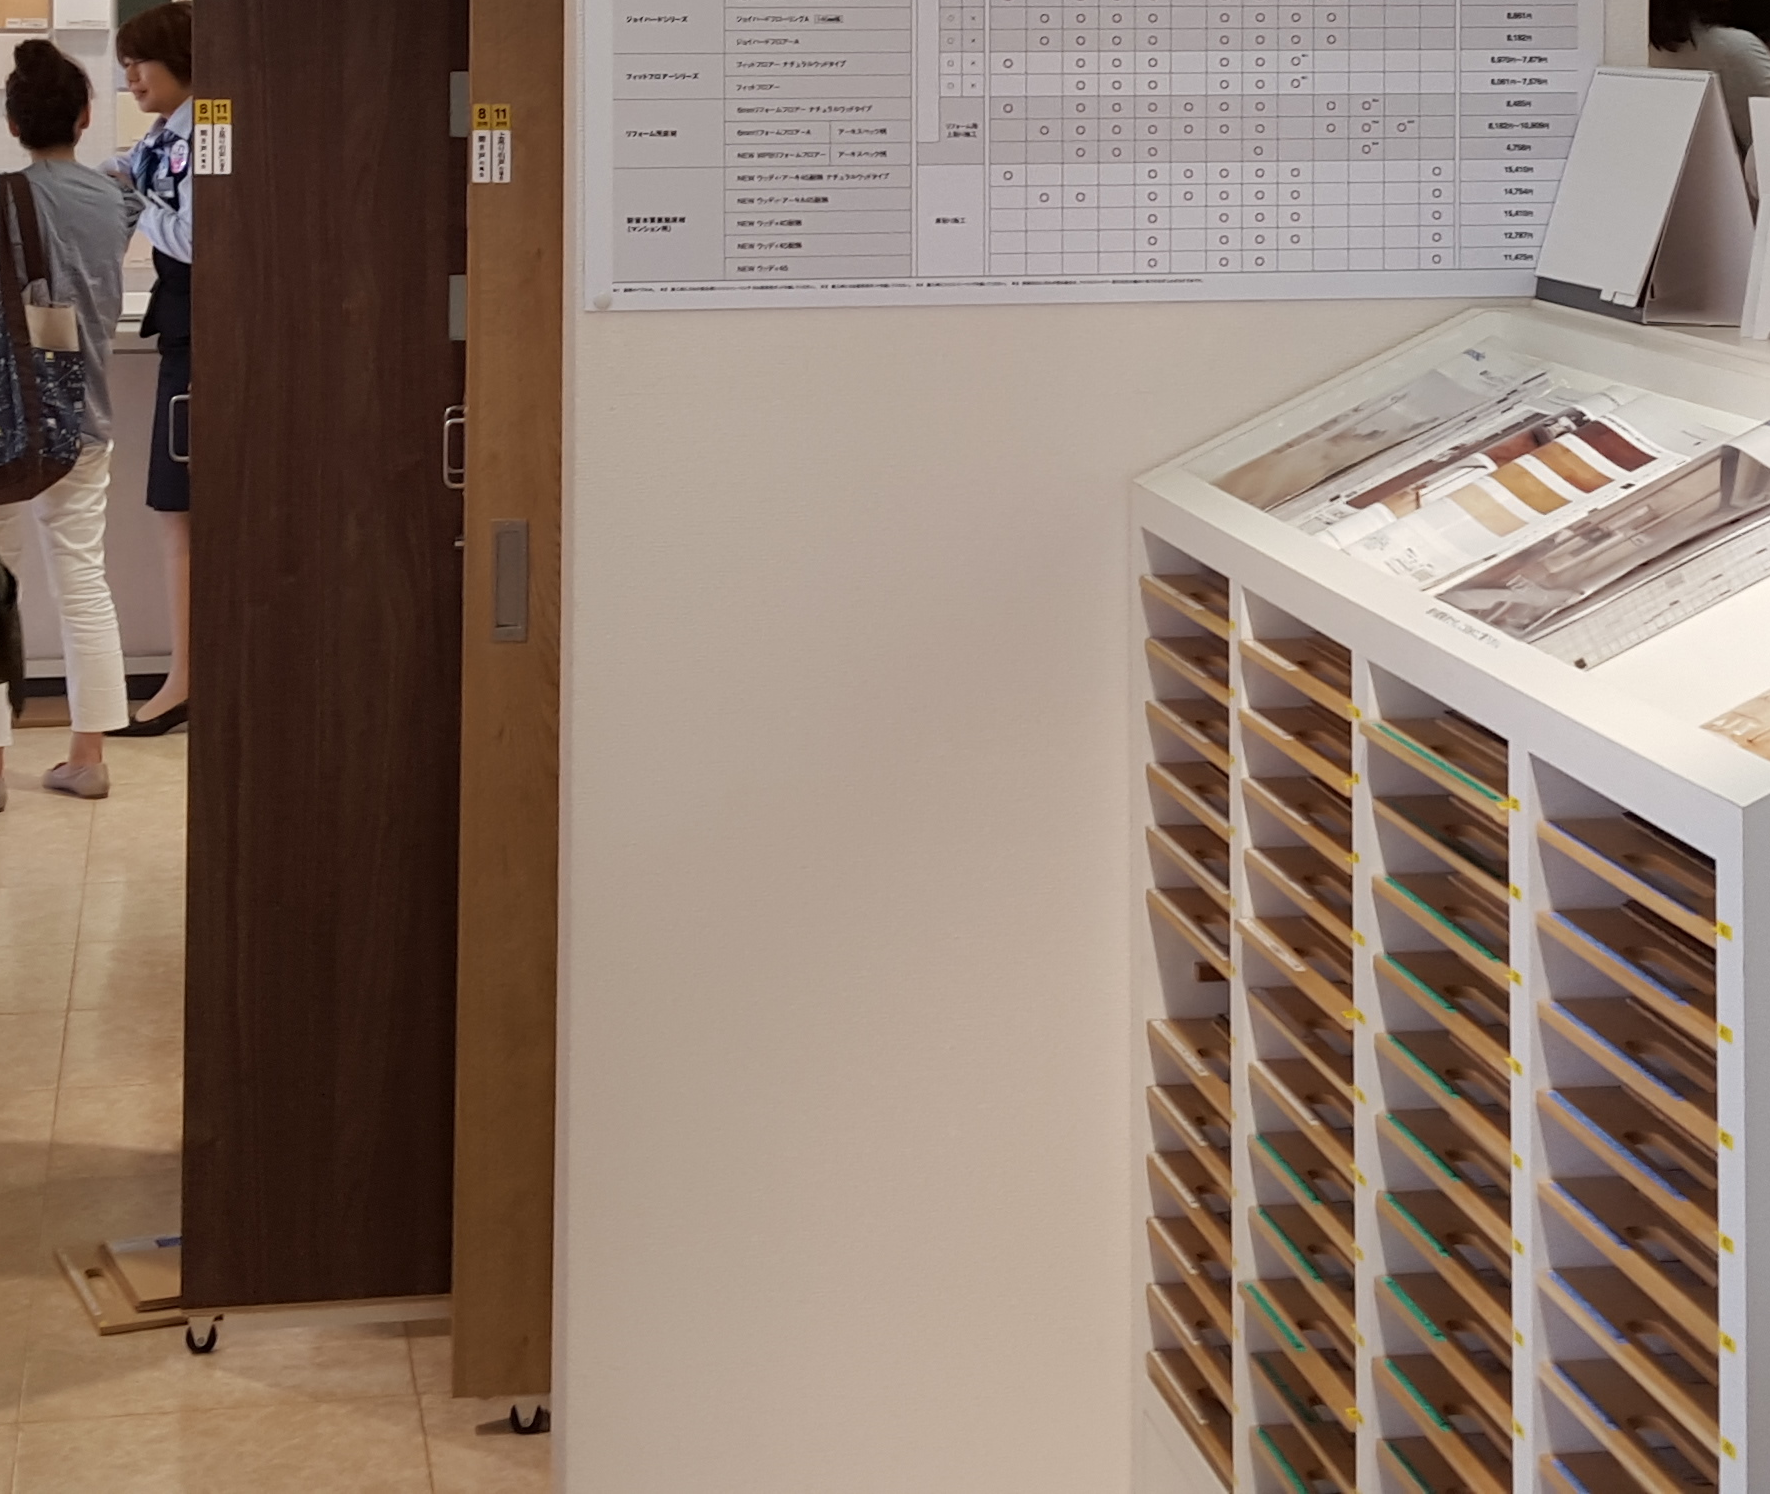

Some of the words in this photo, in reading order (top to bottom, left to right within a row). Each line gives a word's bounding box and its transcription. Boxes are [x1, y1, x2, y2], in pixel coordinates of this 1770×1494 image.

[199, 103, 208, 115] 8
[213, 103, 227, 114] 11
[478, 107, 486, 119] 8
[494, 107, 507, 119] 11
